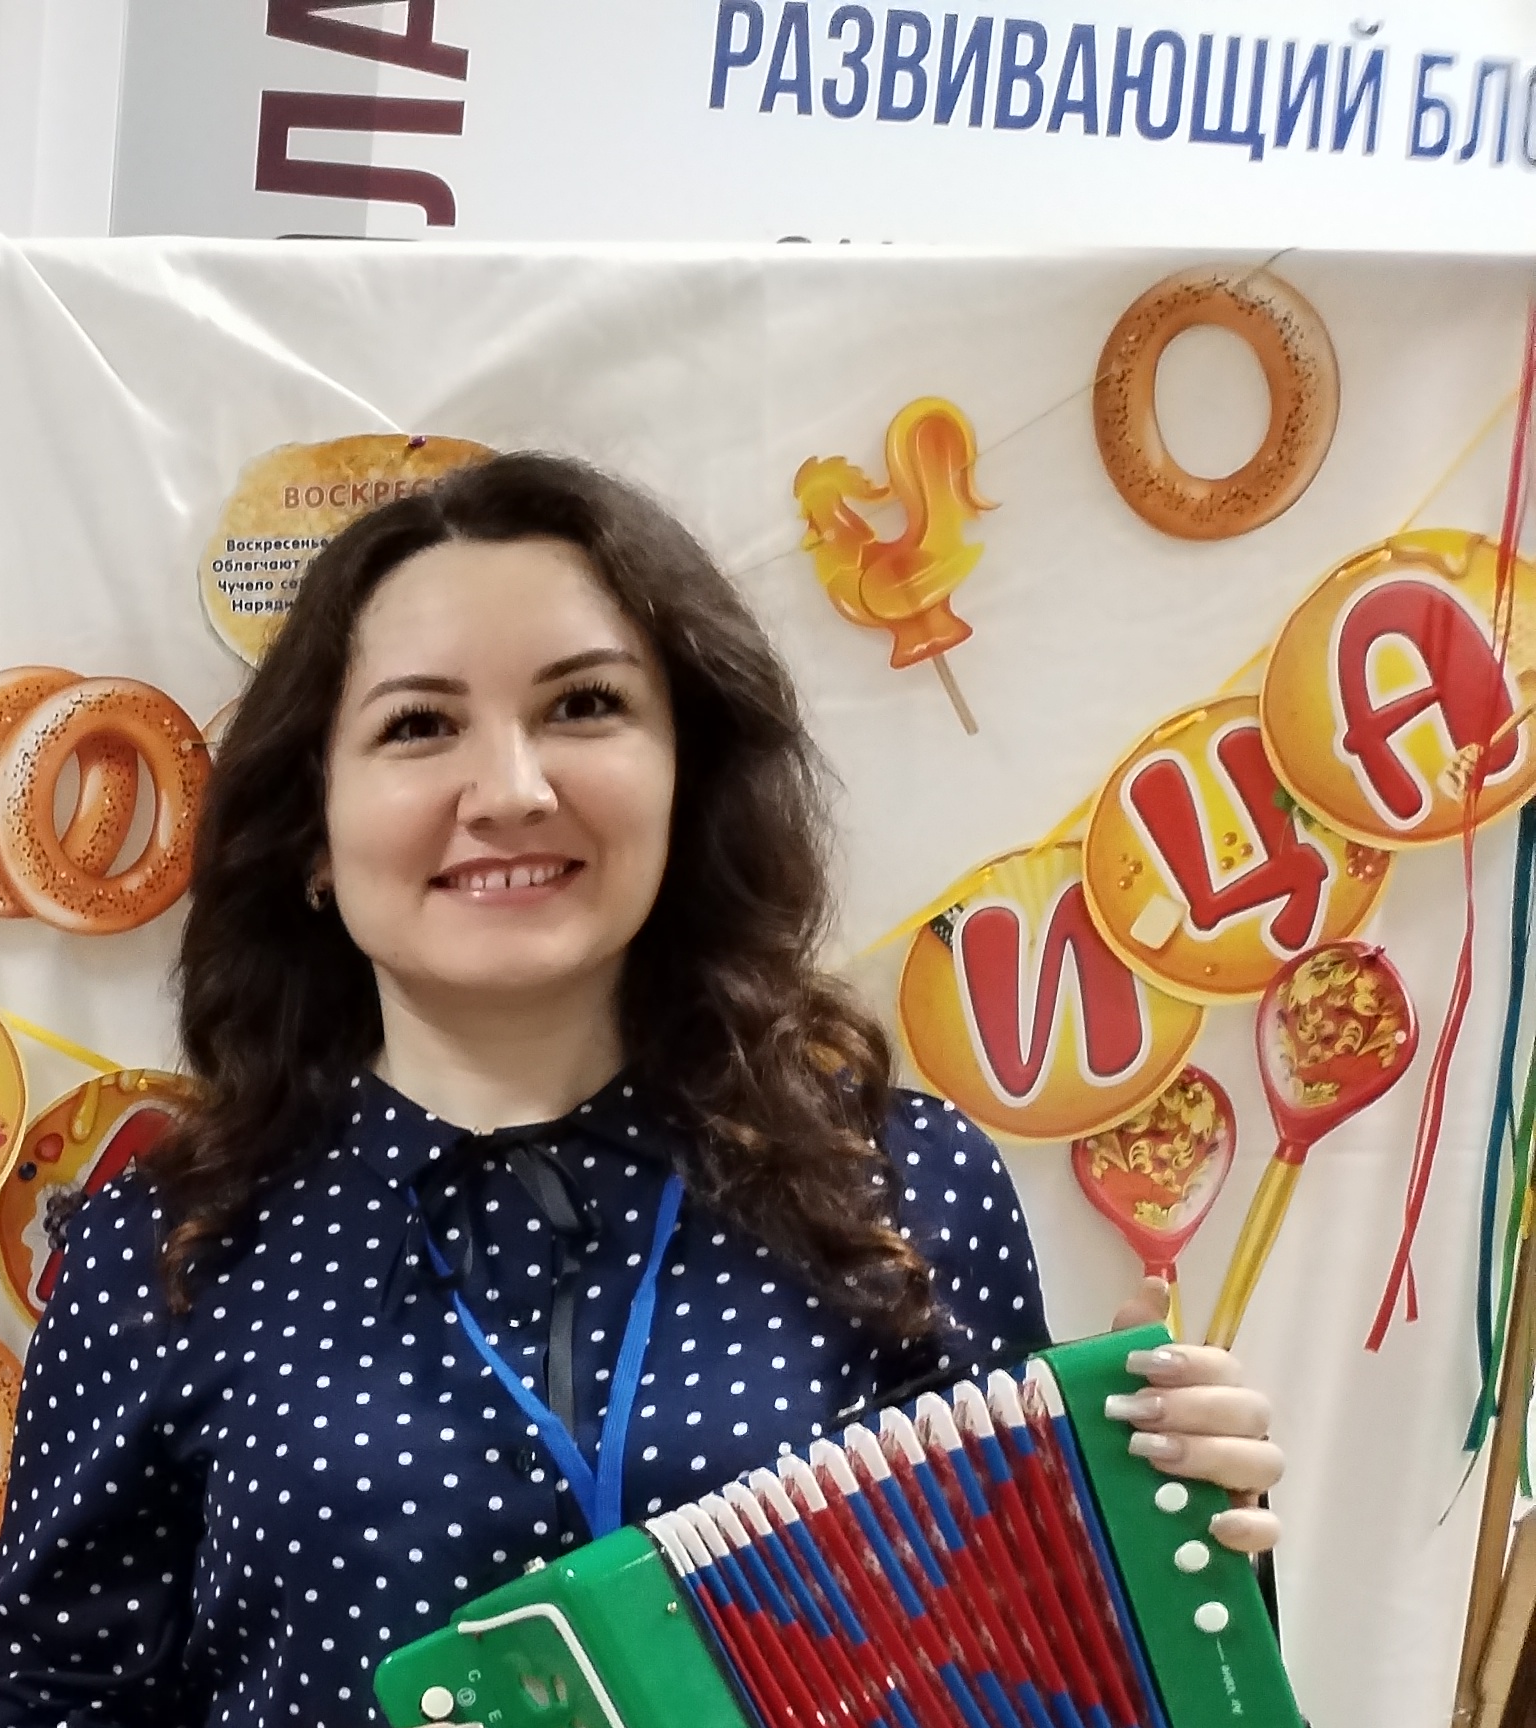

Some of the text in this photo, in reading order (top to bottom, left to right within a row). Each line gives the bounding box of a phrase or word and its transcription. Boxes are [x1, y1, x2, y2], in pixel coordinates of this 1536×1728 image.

[255, 0, 469, 240] ЛА
[709, 0, 1386, 161] РАЗВИВАЮЩИЙ
[212, 559, 301, 573] Облегчают
[217, 580, 274, 596] Чучело
